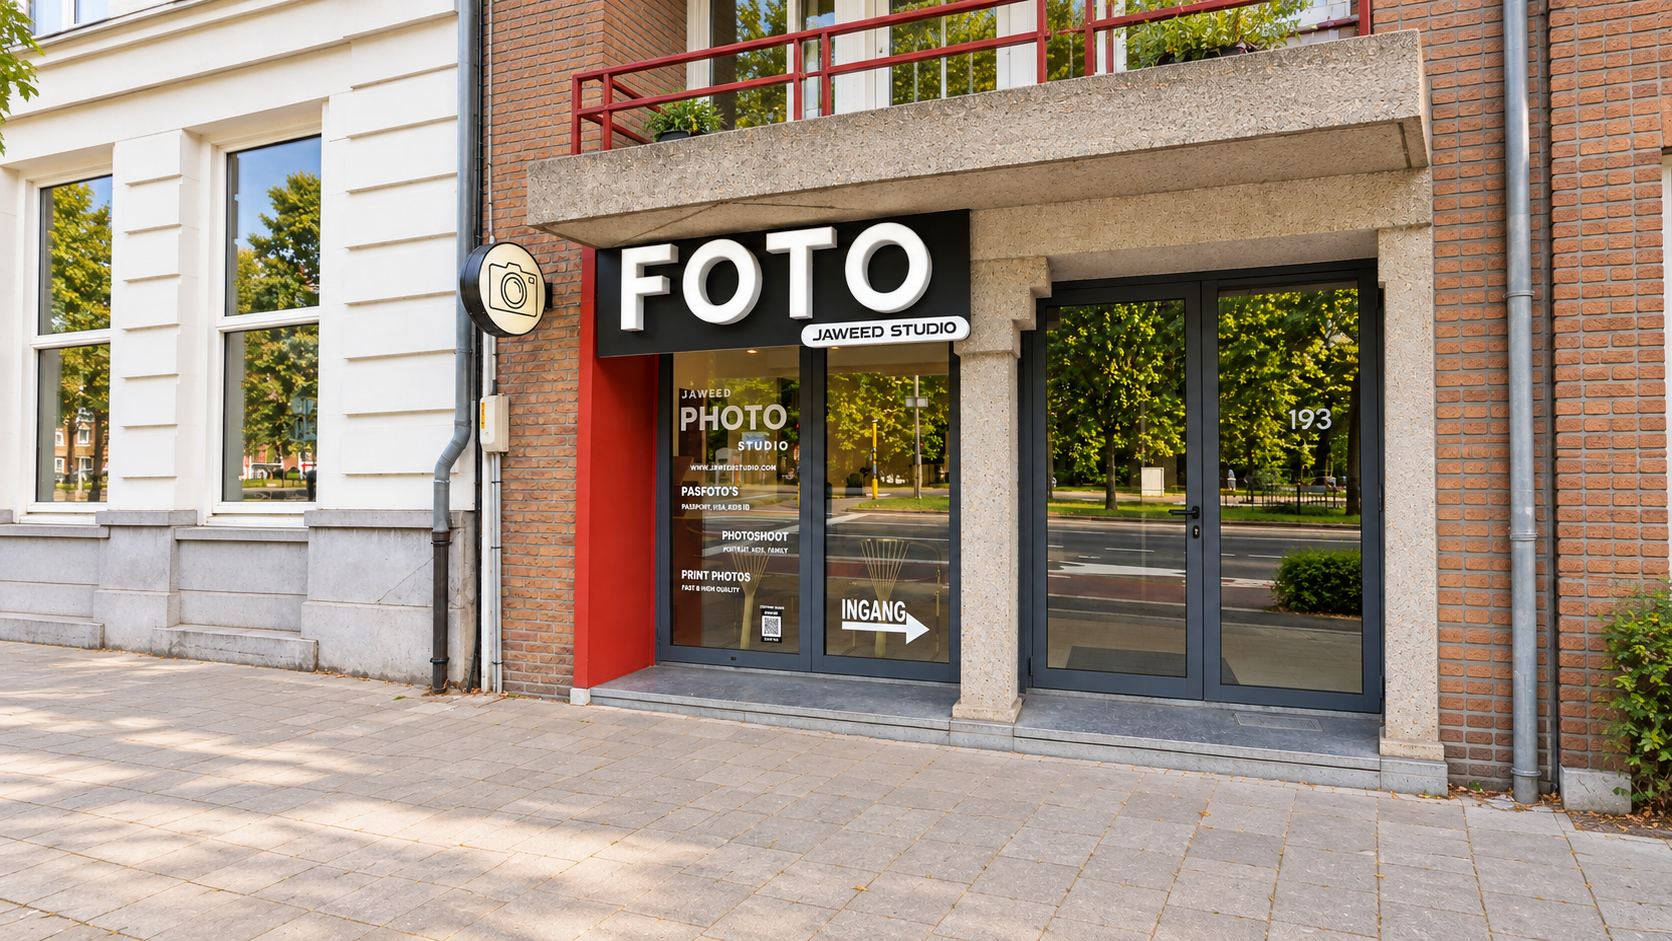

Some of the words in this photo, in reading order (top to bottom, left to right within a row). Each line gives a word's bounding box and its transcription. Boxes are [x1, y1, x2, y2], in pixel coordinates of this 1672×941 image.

[621, 222, 933, 332] FOTO
[813, 326, 884, 341] JAWEED
[891, 321, 957, 337] STUDIO
[681, 388, 731, 399] JAWEED
[680, 403, 788, 432] PHOTO
[1288, 408, 1332, 430] 193
[737, 440, 789, 451] STUDIO
[681, 486, 739, 497] PASFOTO'S
[722, 530, 789, 542] PHOTOSHOOT
[681, 569, 710, 580] PRINT
[711, 570, 751, 582] PHOTOS
[841, 598, 906, 623] INGANG
